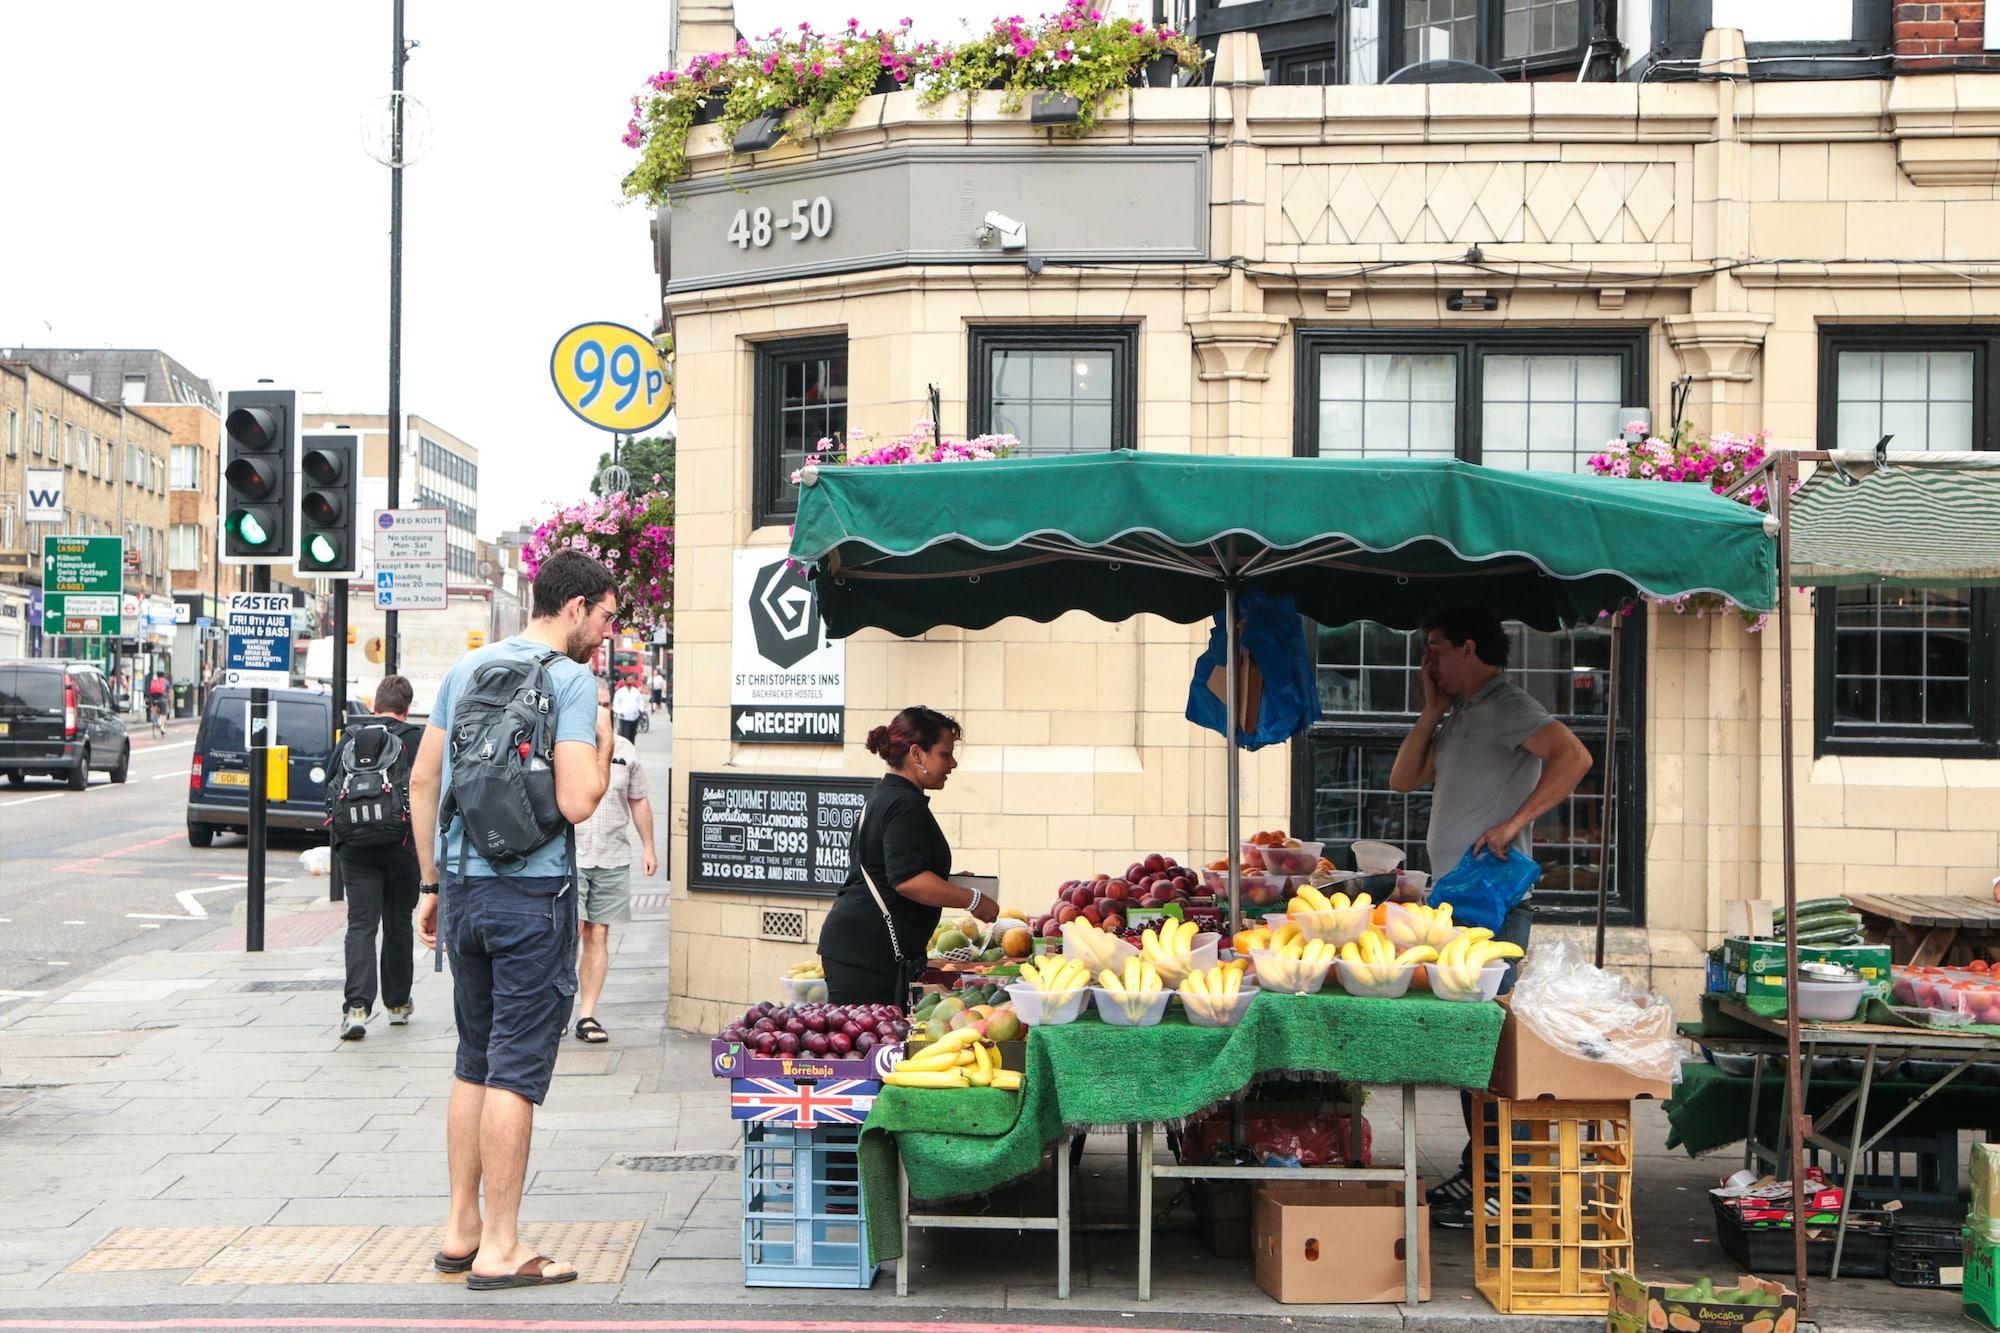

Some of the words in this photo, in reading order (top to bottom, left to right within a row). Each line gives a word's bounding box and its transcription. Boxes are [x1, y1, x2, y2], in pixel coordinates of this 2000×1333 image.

[727, 195, 832, 249] 48-50
[573, 340, 663, 412] 99p
[29, 490, 60, 507] W
[57, 537, 90, 546] Holloway
[401, 534, 433, 542] stopping
[57, 562, 97, 570] Hampstead
[232, 596, 289, 610] FASTER
[232, 615, 247, 625] FRI
[249, 616, 265, 626] 8TH
[266, 616, 286, 627] AUG
[229, 625, 255, 635] DRUM
[257, 627, 264, 636] &
[265, 627, 289, 637] BASS
[735, 674, 746, 685] ST
[749, 674, 816, 685] CHRISTOPHER'S
[819, 674, 840, 685] INNS
[752, 689, 793, 699] BACKPACKER
[795, 689, 823, 699] HOSTELS
[754, 712, 840, 734] RECEPTION
[726, 789, 769, 810] GOURMET
[770, 790, 808, 811] BURGER
[818, 792, 865, 807] BURGERS
[703, 806, 753, 823] Revolution
[753, 814, 762, 825] IN
[762, 812, 808, 829] LONDON'S
[730, 835, 742, 843] WC2
[746, 826, 774, 840] BACK
[816, 830, 852, 847] WIN
[746, 839, 759, 851] IN
[773, 831, 808, 853] 1993
[750, 856, 765, 864] SINCE
[766, 856, 780, 864] THEN
[783, 857, 793, 865] BUT
[795, 858, 807, 866] GET
[815, 847, 851, 867] NACH
[702, 862, 765, 879] BIGGER
[767, 866, 783, 880] AND
[783, 867, 808, 881] BETTER
